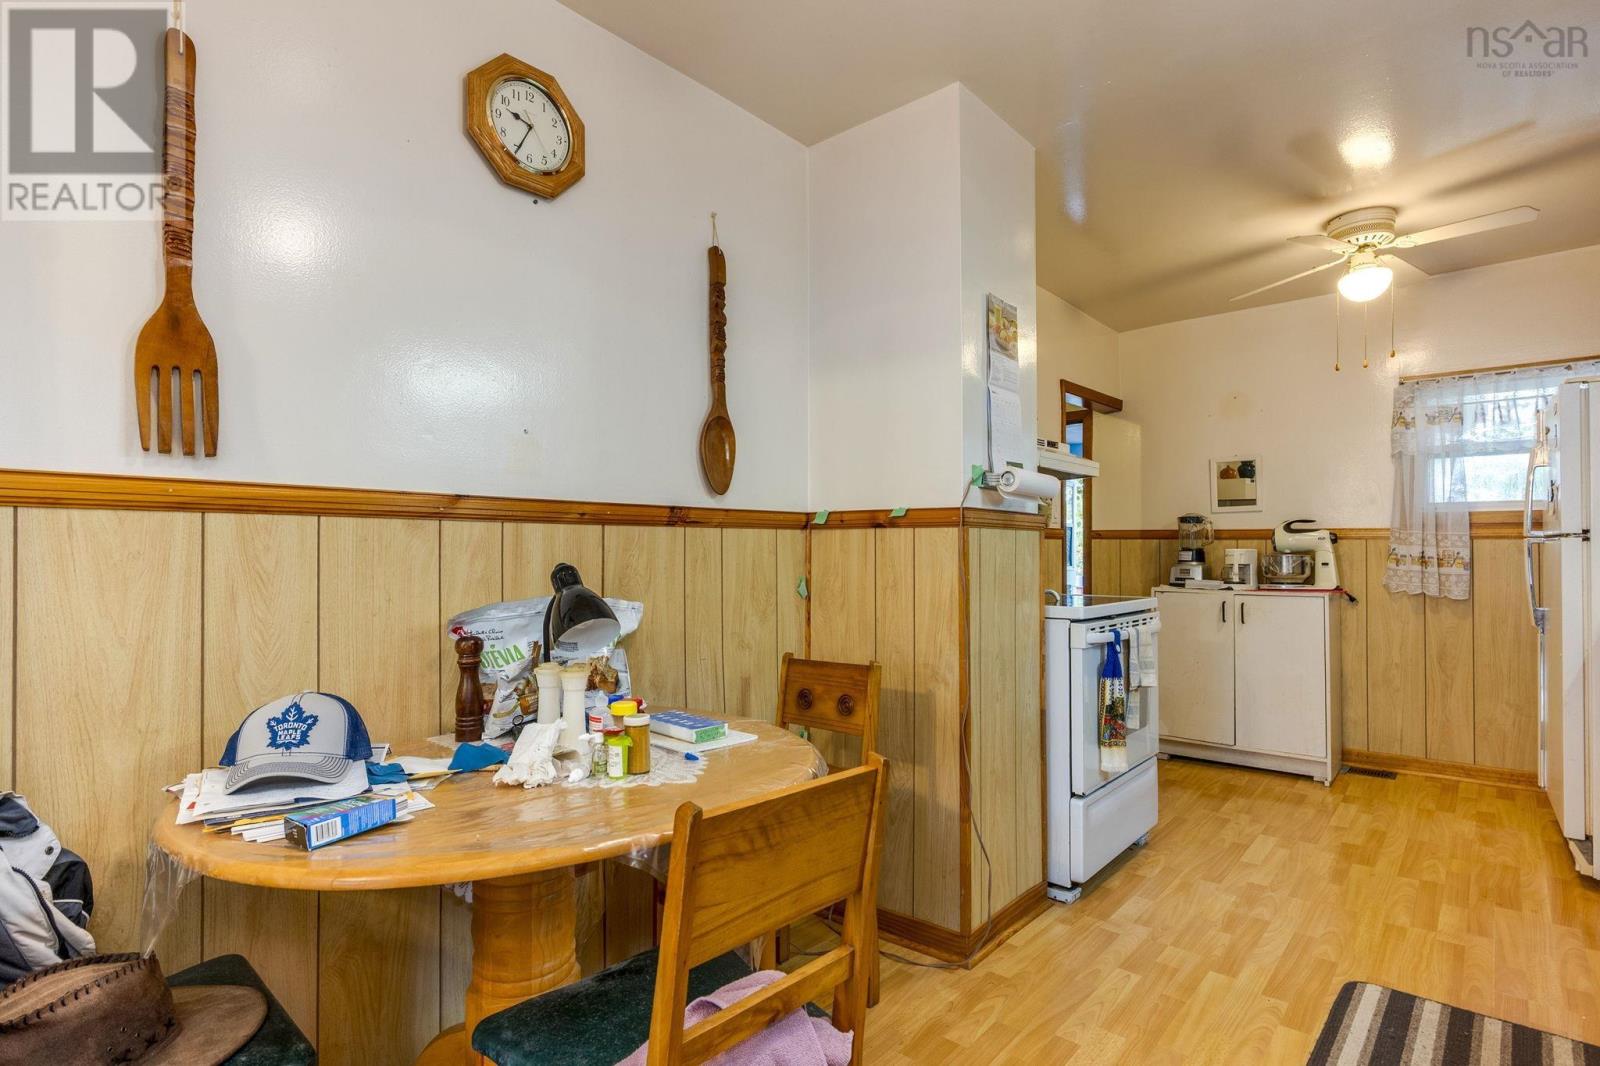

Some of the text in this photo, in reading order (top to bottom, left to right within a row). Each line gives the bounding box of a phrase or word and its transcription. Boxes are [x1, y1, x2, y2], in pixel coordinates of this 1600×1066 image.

[512, 89, 521, 101] 11
[525, 90, 535, 103] 12
[501, 94, 510, 107] 10
[495, 109, 502, 119] 9
[551, 118, 558, 128] 2
[500, 127, 507, 137] 8
[556, 135, 563, 145] 3
[526, 153, 533, 164] 6
[551, 149, 557, 158] 4
[541, 156, 548, 166] 5
[274, 722, 308, 732] TORONTO
